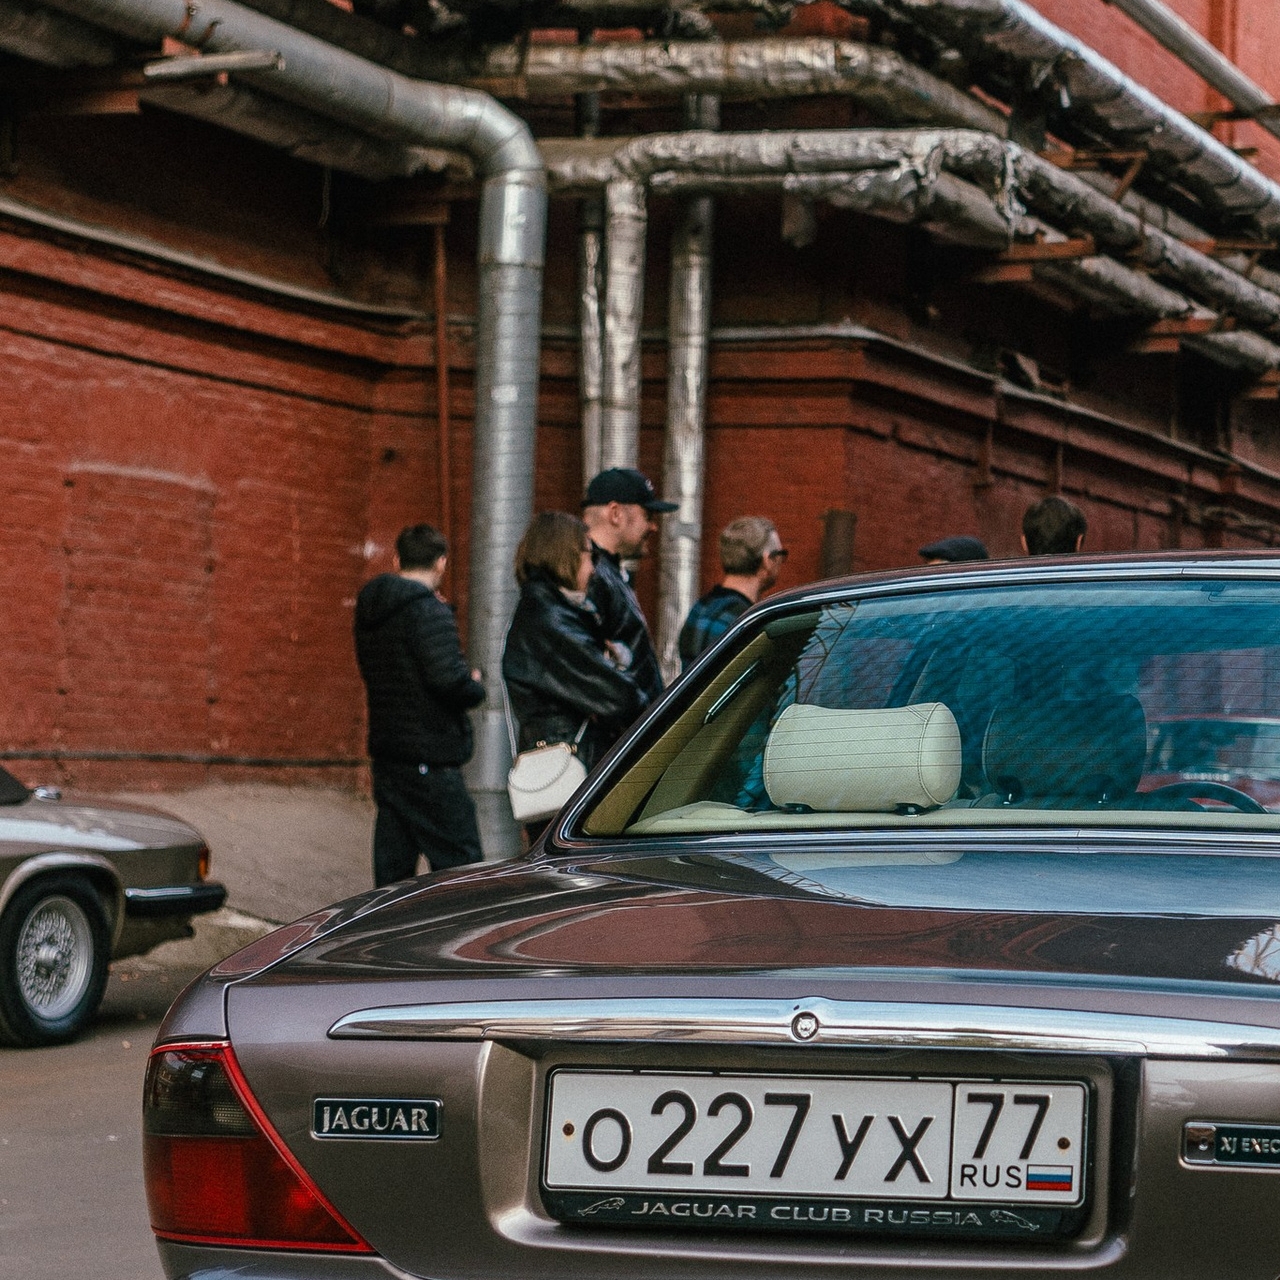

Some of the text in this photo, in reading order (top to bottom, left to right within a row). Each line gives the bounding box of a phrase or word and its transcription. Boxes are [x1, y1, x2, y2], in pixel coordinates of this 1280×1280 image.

[322, 1106, 430, 1132] JAGUAR
[967, 1092, 1051, 1160] 77
[1220, 1136, 1237, 1154] XJ
[960, 1164, 1022, 1188] RUS
[631, 1202, 983, 1226] JAGUAR CLUB RUSSIA
